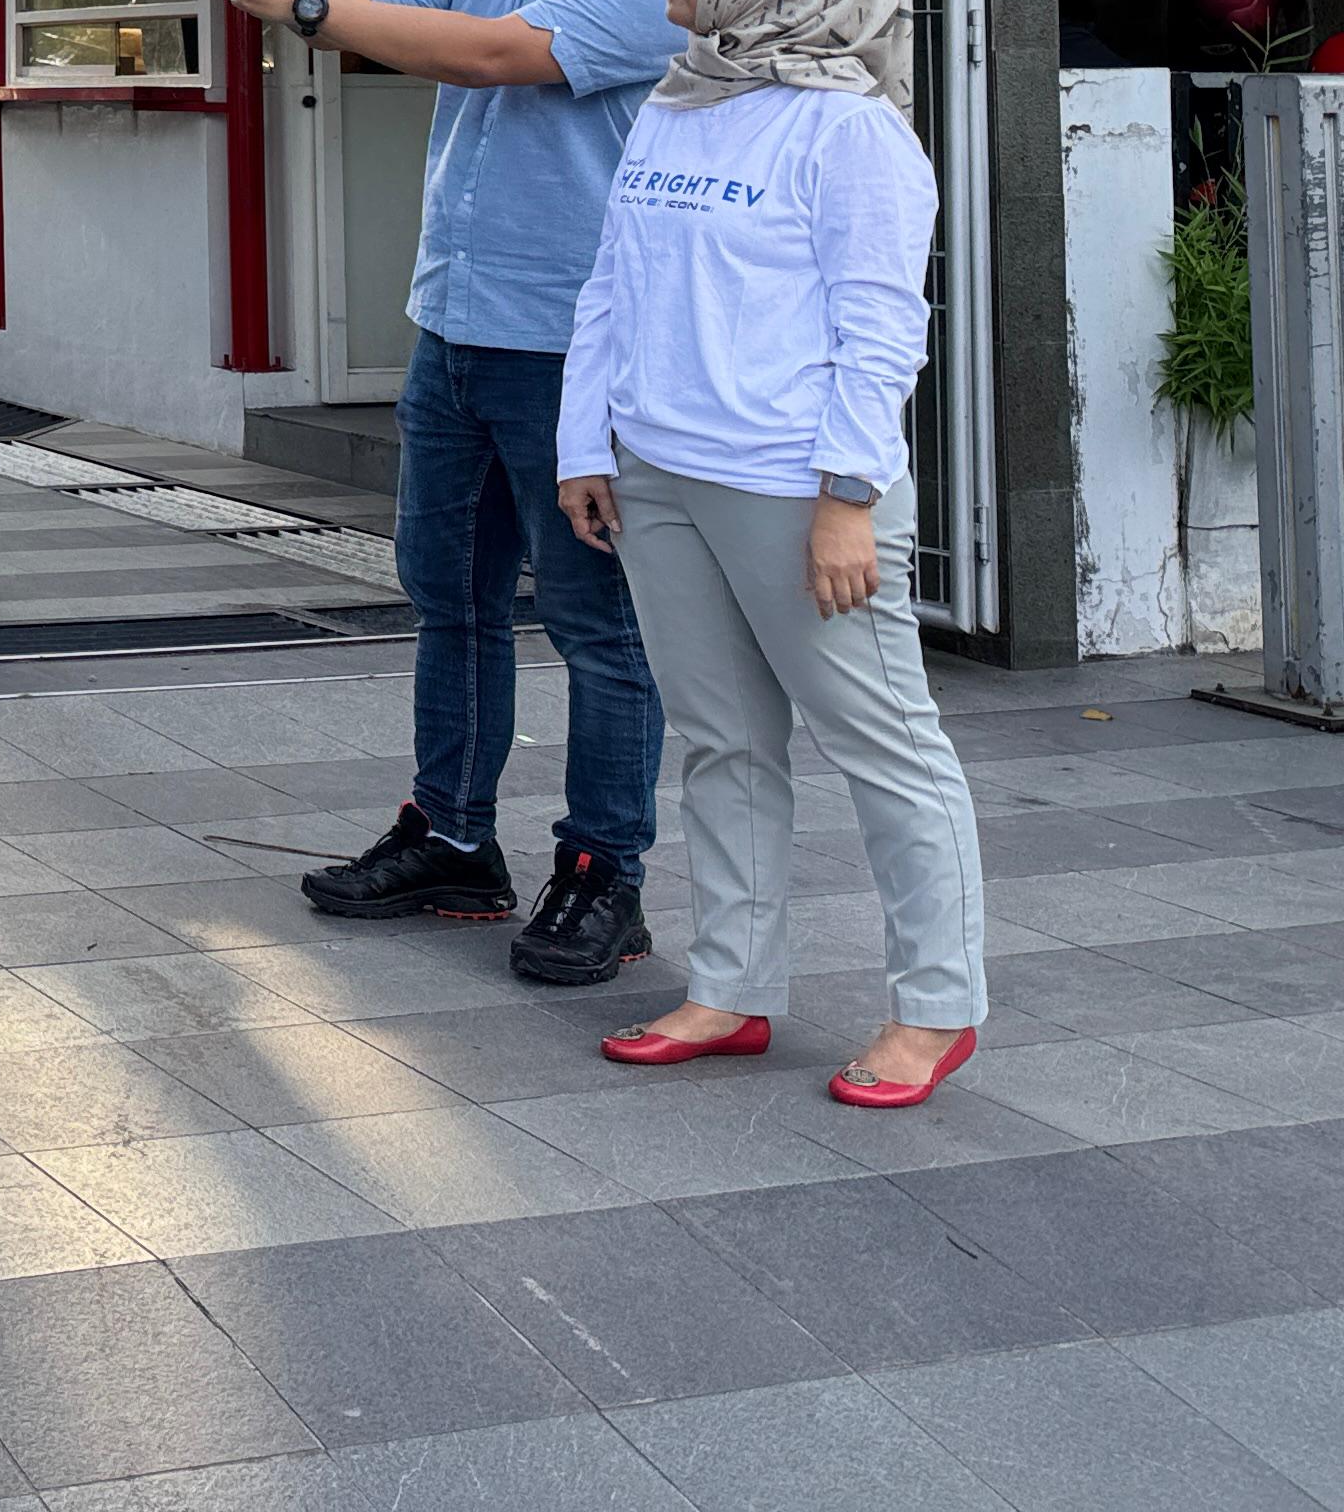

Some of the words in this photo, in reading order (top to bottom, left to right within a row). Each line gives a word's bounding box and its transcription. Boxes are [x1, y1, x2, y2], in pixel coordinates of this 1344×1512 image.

[621, 169, 645, 190] HE
[645, 171, 720, 197] RIGHT
[722, 180, 766, 208] EV
[665, 199, 699, 211] ICON
